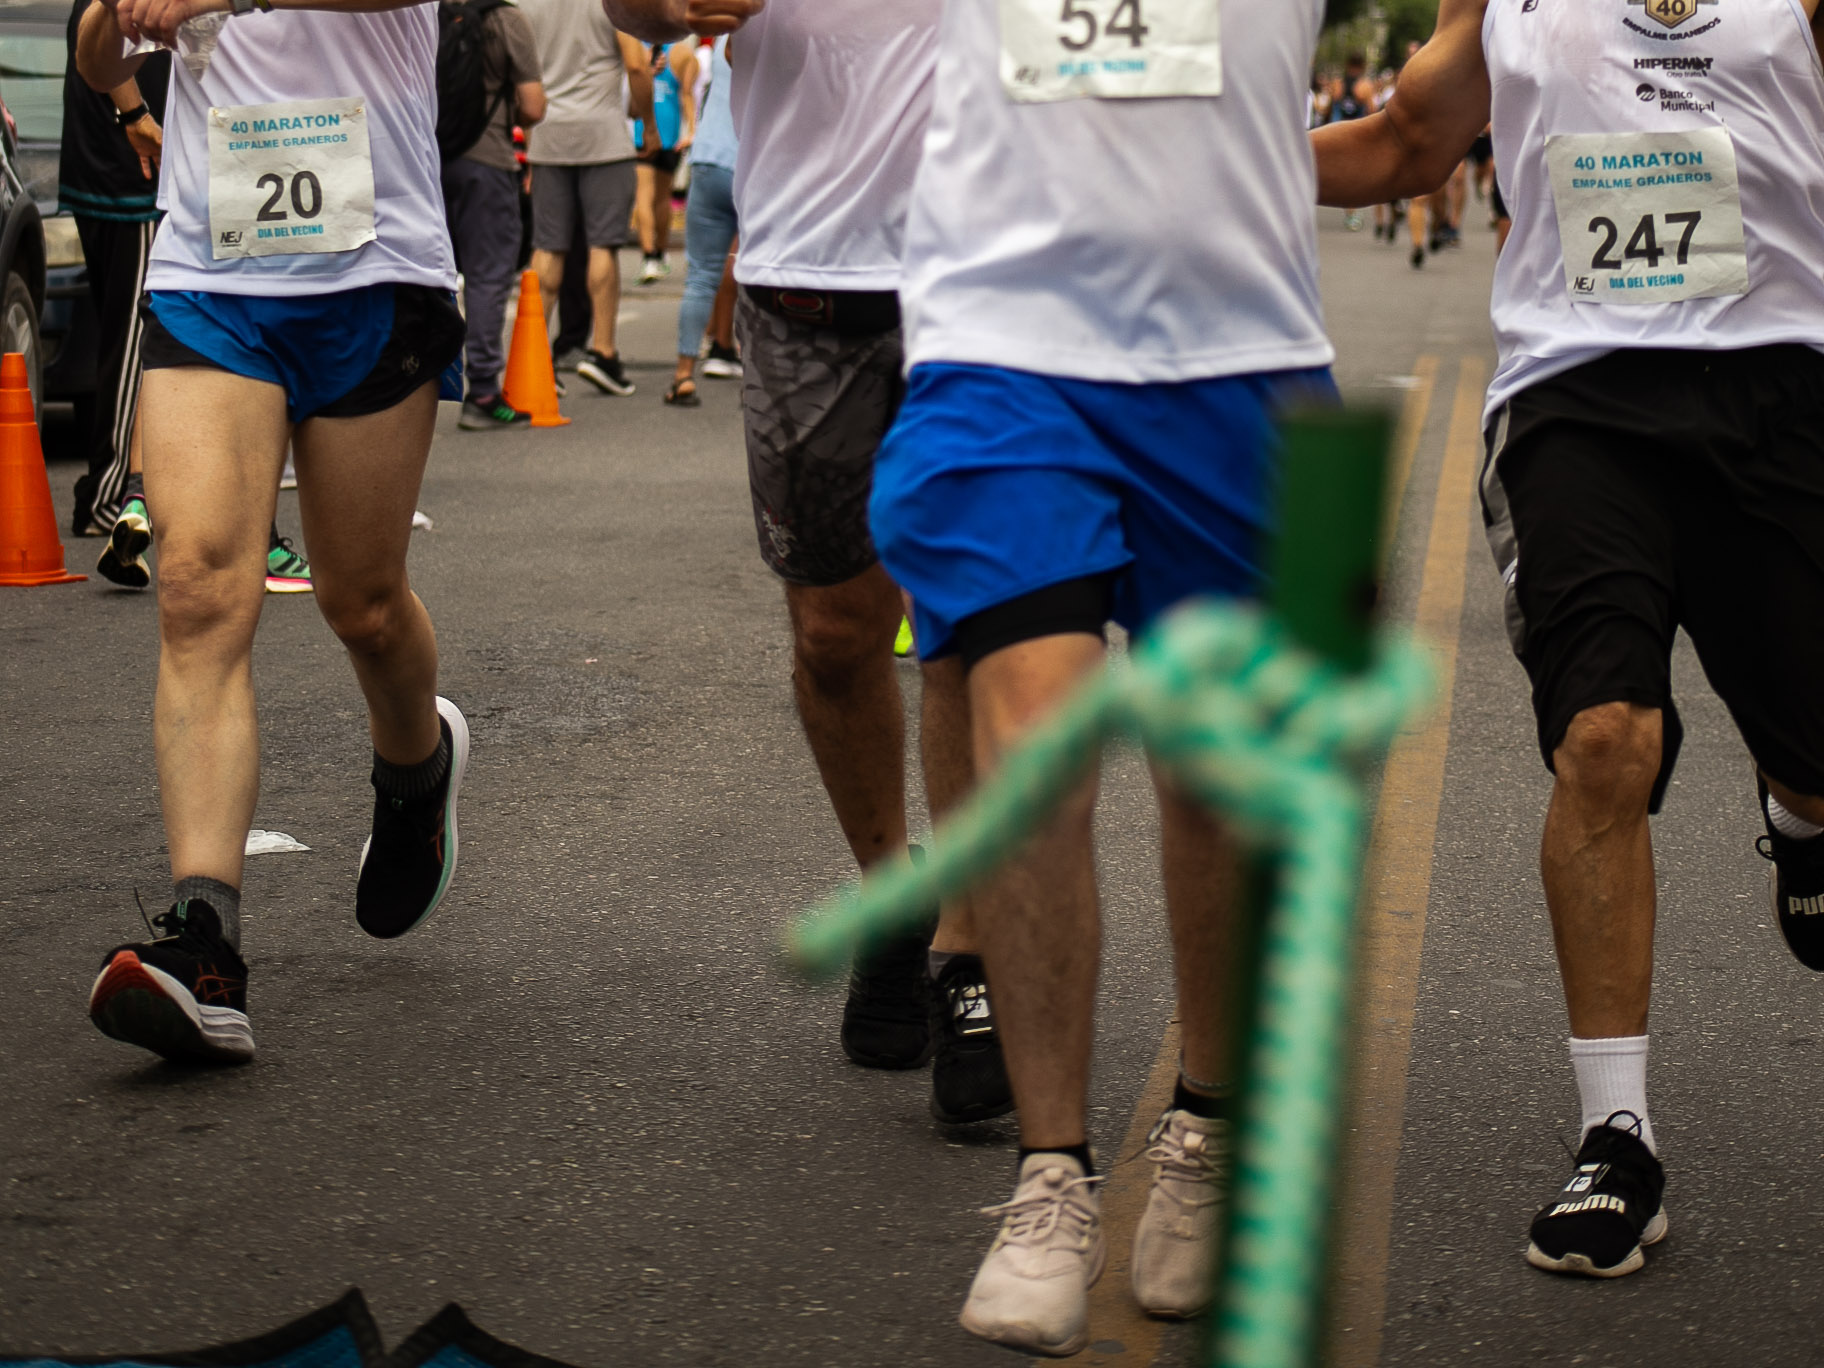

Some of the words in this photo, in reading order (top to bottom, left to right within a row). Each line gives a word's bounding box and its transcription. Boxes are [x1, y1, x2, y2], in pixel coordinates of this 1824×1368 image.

[1656, 0, 1686, 16] 40
[1622, 17, 1668, 41] EMPALME
[1669, 17, 1721, 41] GRANEROS
[1659, 88, 1693, 99] Banco
[1660, 100, 1715, 113] Municipal
[231, 121, 249, 134] 40
[253, 114, 340, 133] MARATON
[229, 139, 280, 151] EMPALME
[283, 133, 348, 147] GRANEROS
[1574, 156, 1596, 171] 40
[1602, 151, 1703, 170] MARATON
[1572, 177, 1633, 189] EMPALME
[1636, 172, 1712, 187] GRANEROS
[256, 170, 323, 222] 20
[257, 228, 273, 239] DIA
[274, 227, 290, 238] DEL
[291, 224, 324, 236] VECINO
[1587, 210, 1702, 270] 247
[1609, 277, 1625, 289] DIA
[1627, 277, 1645, 288] DEL
[1646, 273, 1684, 287] VECINO
[1788, 893, 1824, 915] PU
[1548, 1194, 1626, 1217] PUMA
